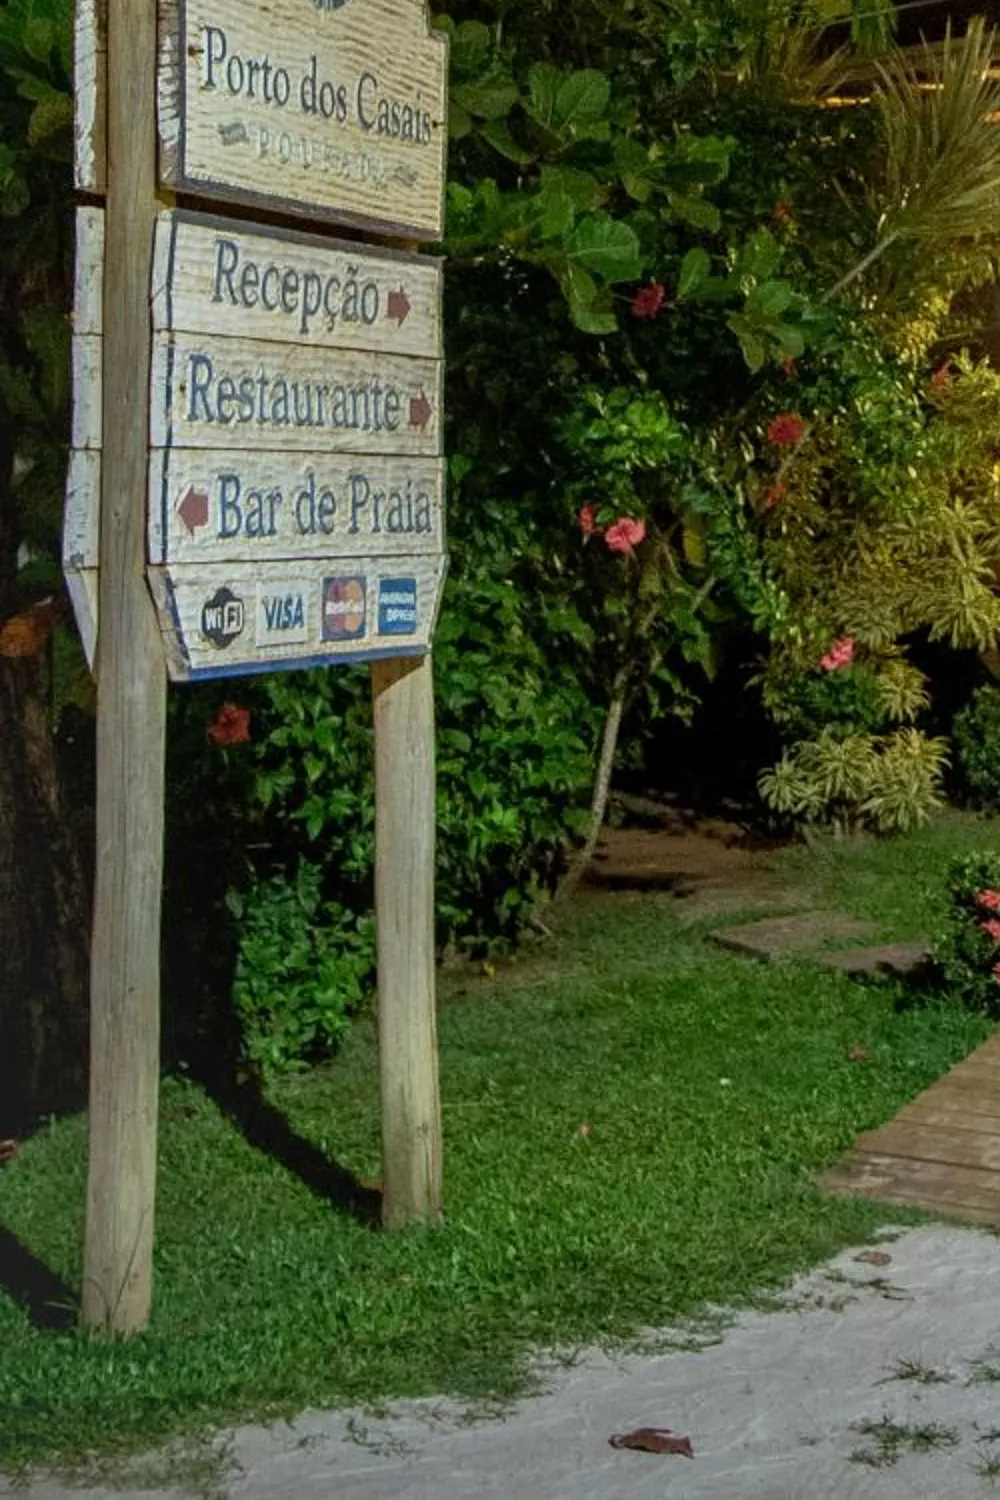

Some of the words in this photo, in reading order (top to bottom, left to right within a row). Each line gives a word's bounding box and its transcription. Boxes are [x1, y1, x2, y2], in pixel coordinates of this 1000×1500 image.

[200, 25, 290, 106] Porto
[300, 55, 347, 122] dos
[356, 72, 432, 145] Casais
[211, 238, 380, 334] Recepção
[186, 354, 400, 431] Restaurante
[216, 475, 283, 539] Bar
[294, 470, 337, 535] de
[347, 473, 432, 534] Praia
[262, 594, 304, 630] VISA
